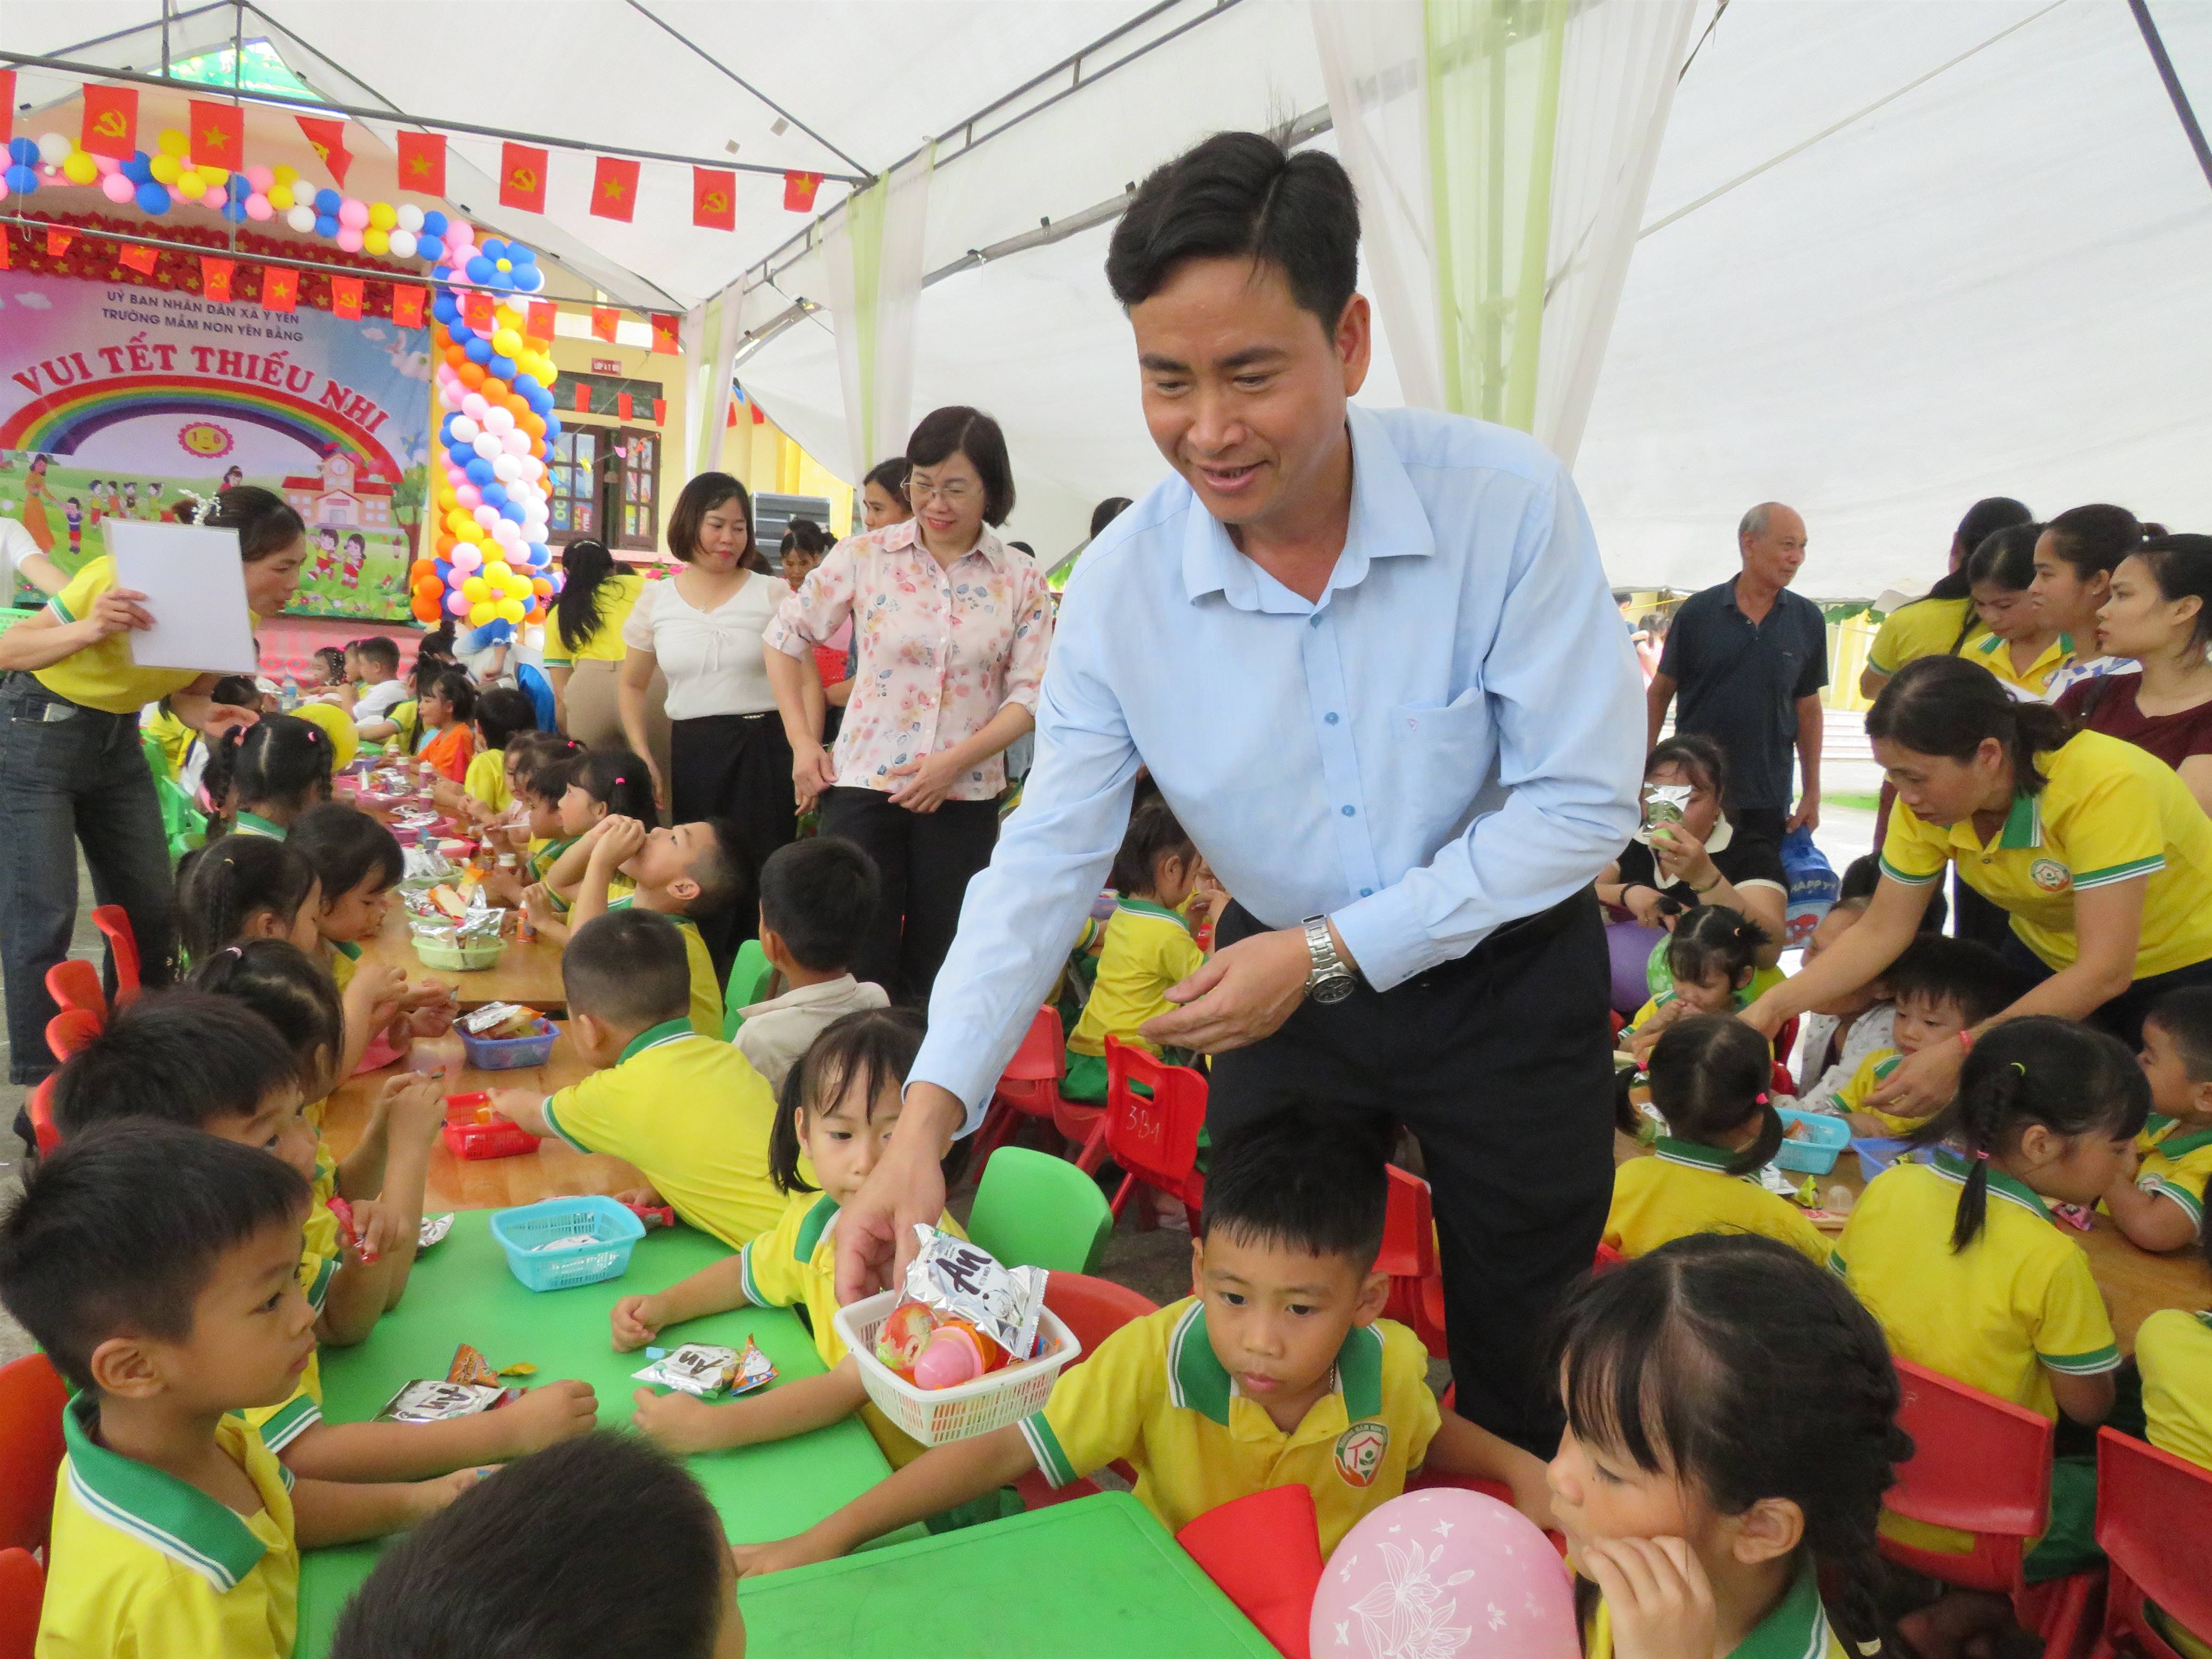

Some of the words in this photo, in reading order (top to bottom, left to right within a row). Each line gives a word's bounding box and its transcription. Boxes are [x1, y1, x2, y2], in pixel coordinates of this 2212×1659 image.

[130, 294, 158, 307] BAN
[163, 299, 203, 312] NHÂN
[207, 303, 235, 316] DÂN
[103, 309, 160, 324] TRƯỜNG
[165, 313, 199, 329] MẦM
[203, 321, 233, 334] NON
[238, 324, 261, 337] YÊN
[12, 352, 93, 396] VUI
[98, 331, 178, 374] TẾT
[191, 346, 315, 393] THIẾU
[319, 380, 389, 433] NHI
